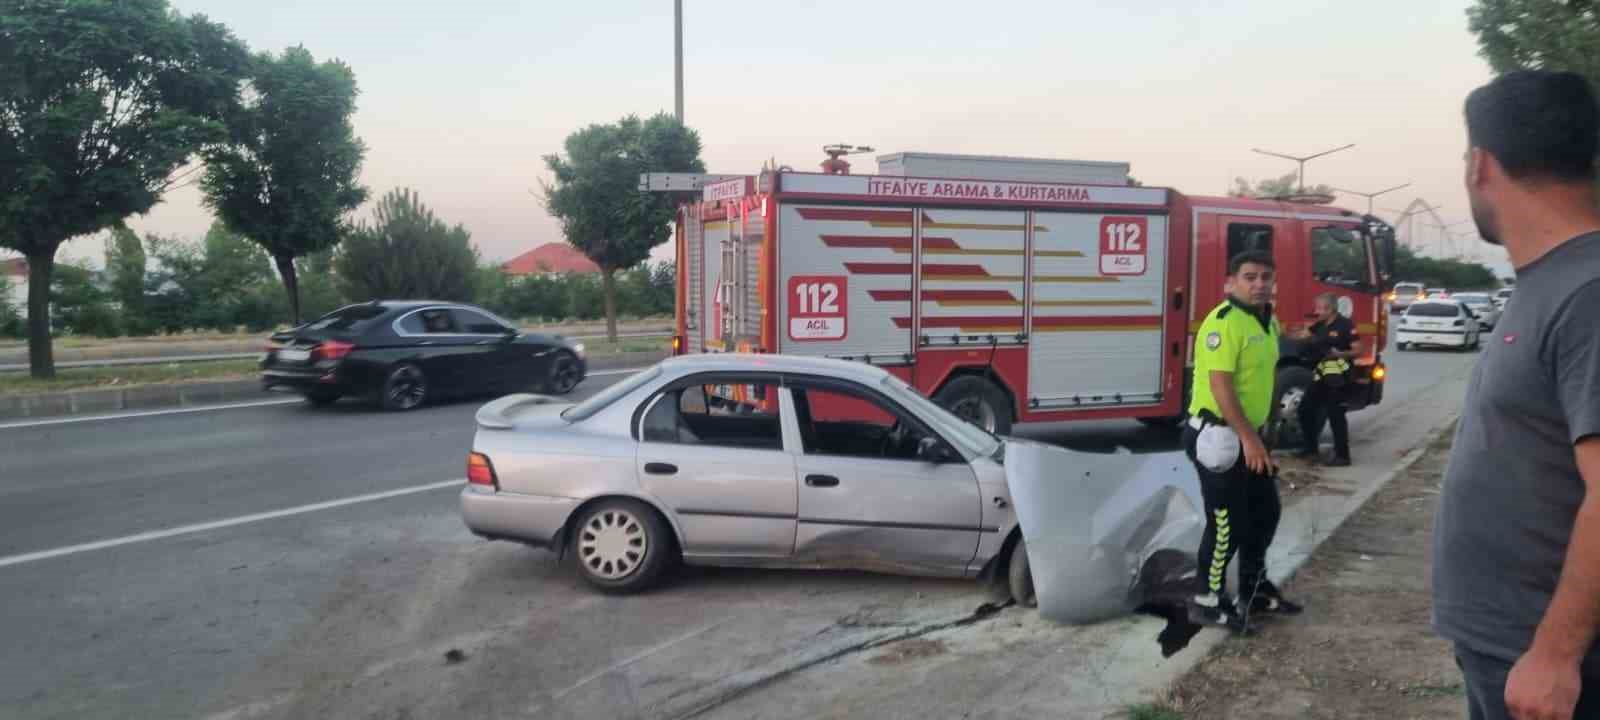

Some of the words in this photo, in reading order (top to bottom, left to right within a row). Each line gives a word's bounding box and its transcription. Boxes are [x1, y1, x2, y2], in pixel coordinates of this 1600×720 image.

[867, 177, 928, 196] İTFAİYE
[932, 183, 989, 198] ARAMA
[992, 186, 1004, 198] &
[1008, 185, 1090, 201] KURTARMA
[1106, 223, 1141, 250] 112
[796, 282, 839, 313] 112
